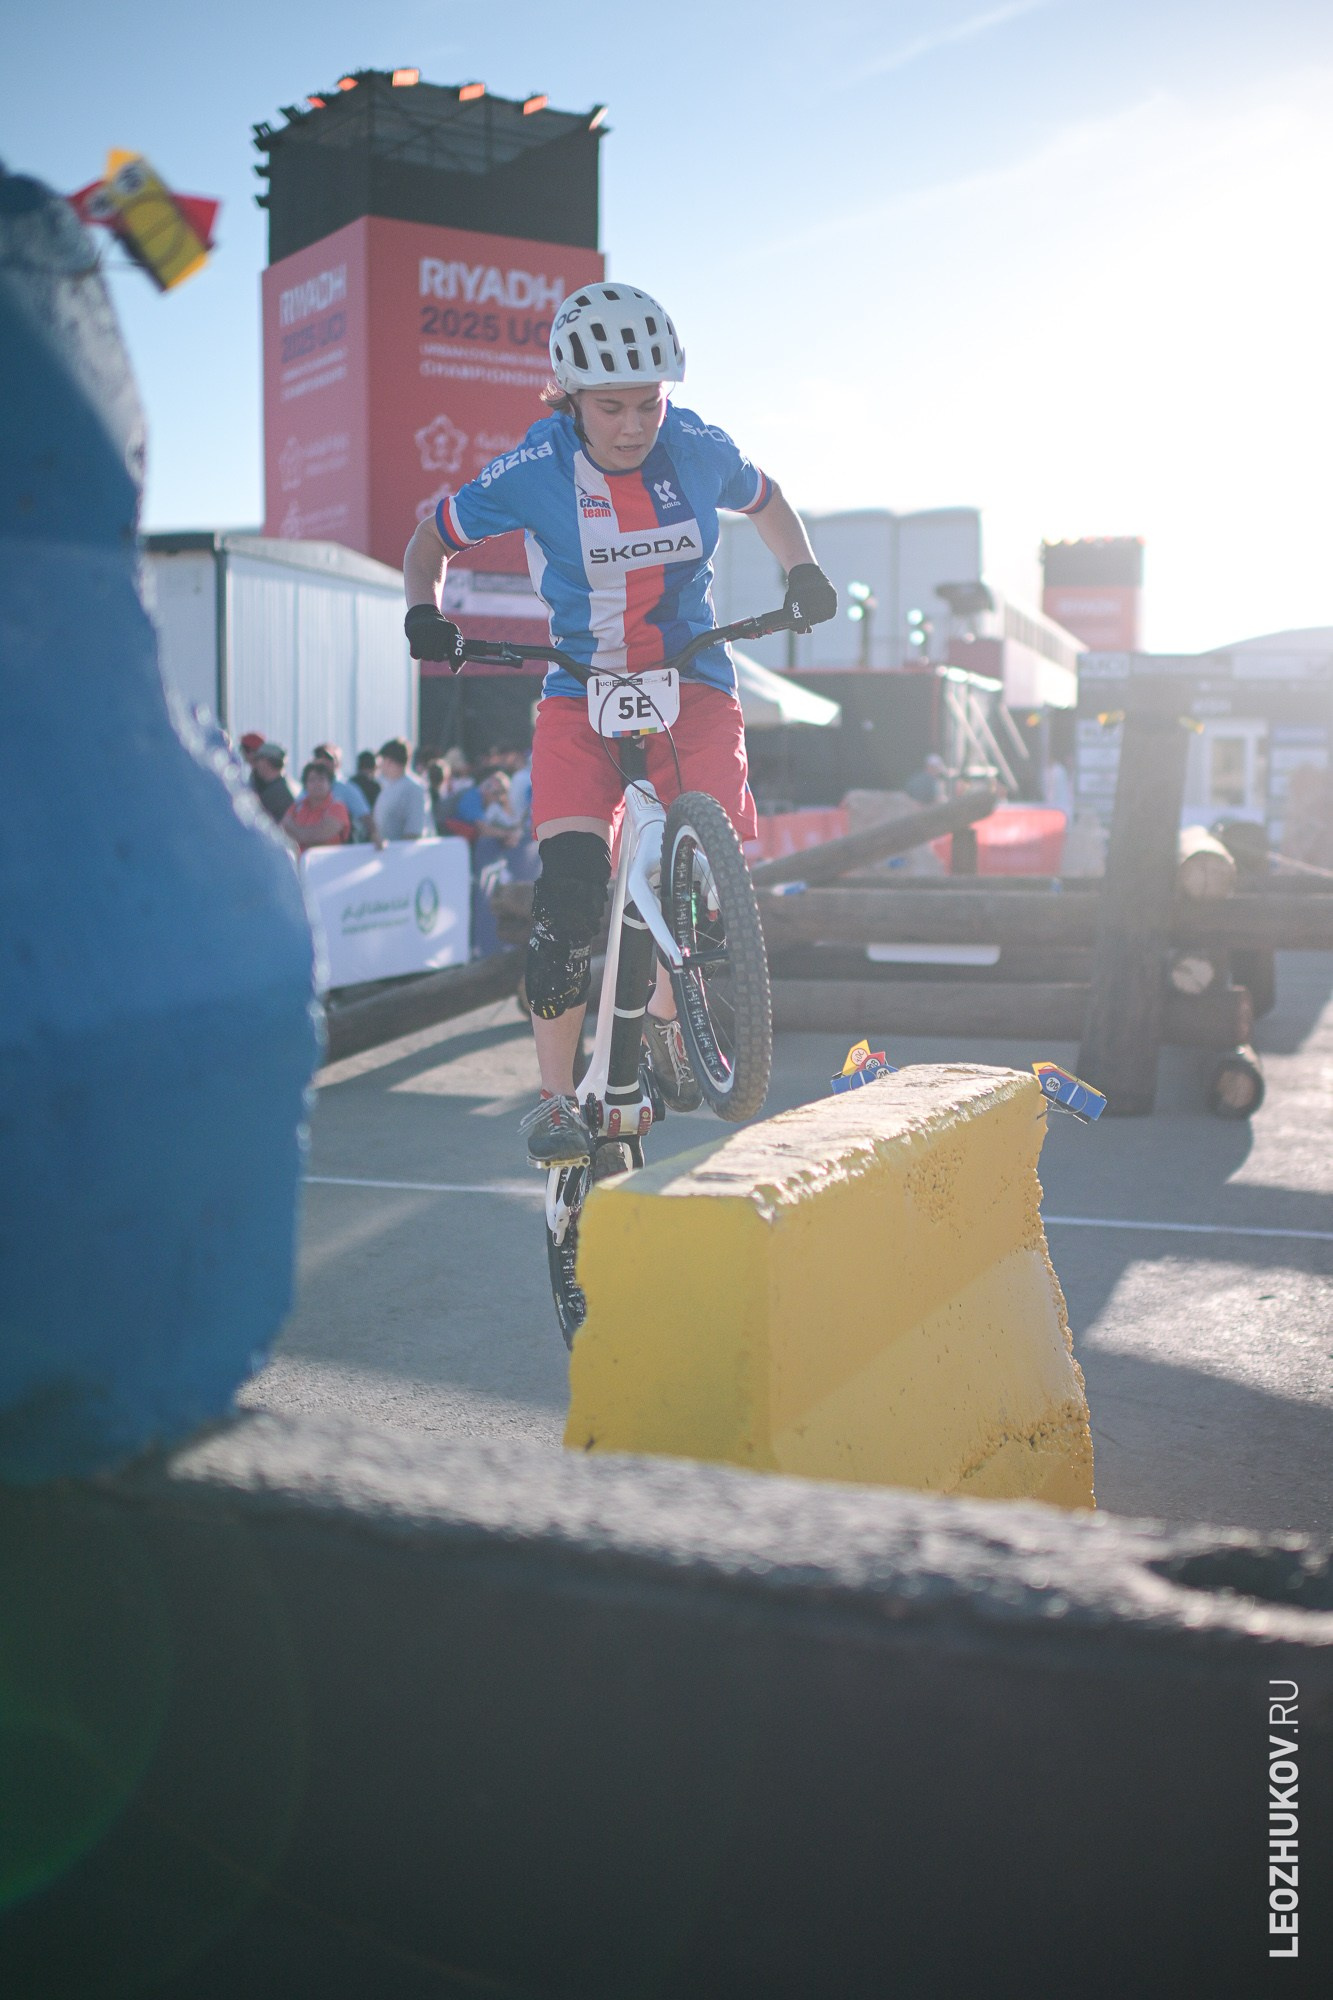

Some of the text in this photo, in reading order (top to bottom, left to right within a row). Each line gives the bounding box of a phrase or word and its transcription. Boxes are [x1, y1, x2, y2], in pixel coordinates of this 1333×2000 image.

[420, 257, 565, 311] RIYADH
[421, 305, 549, 349] 2025 UC
[556, 308, 582, 331] OC
[481, 441, 553, 488] sazka
[583, 508, 611, 518] team
[618, 696, 651, 719] 5E
